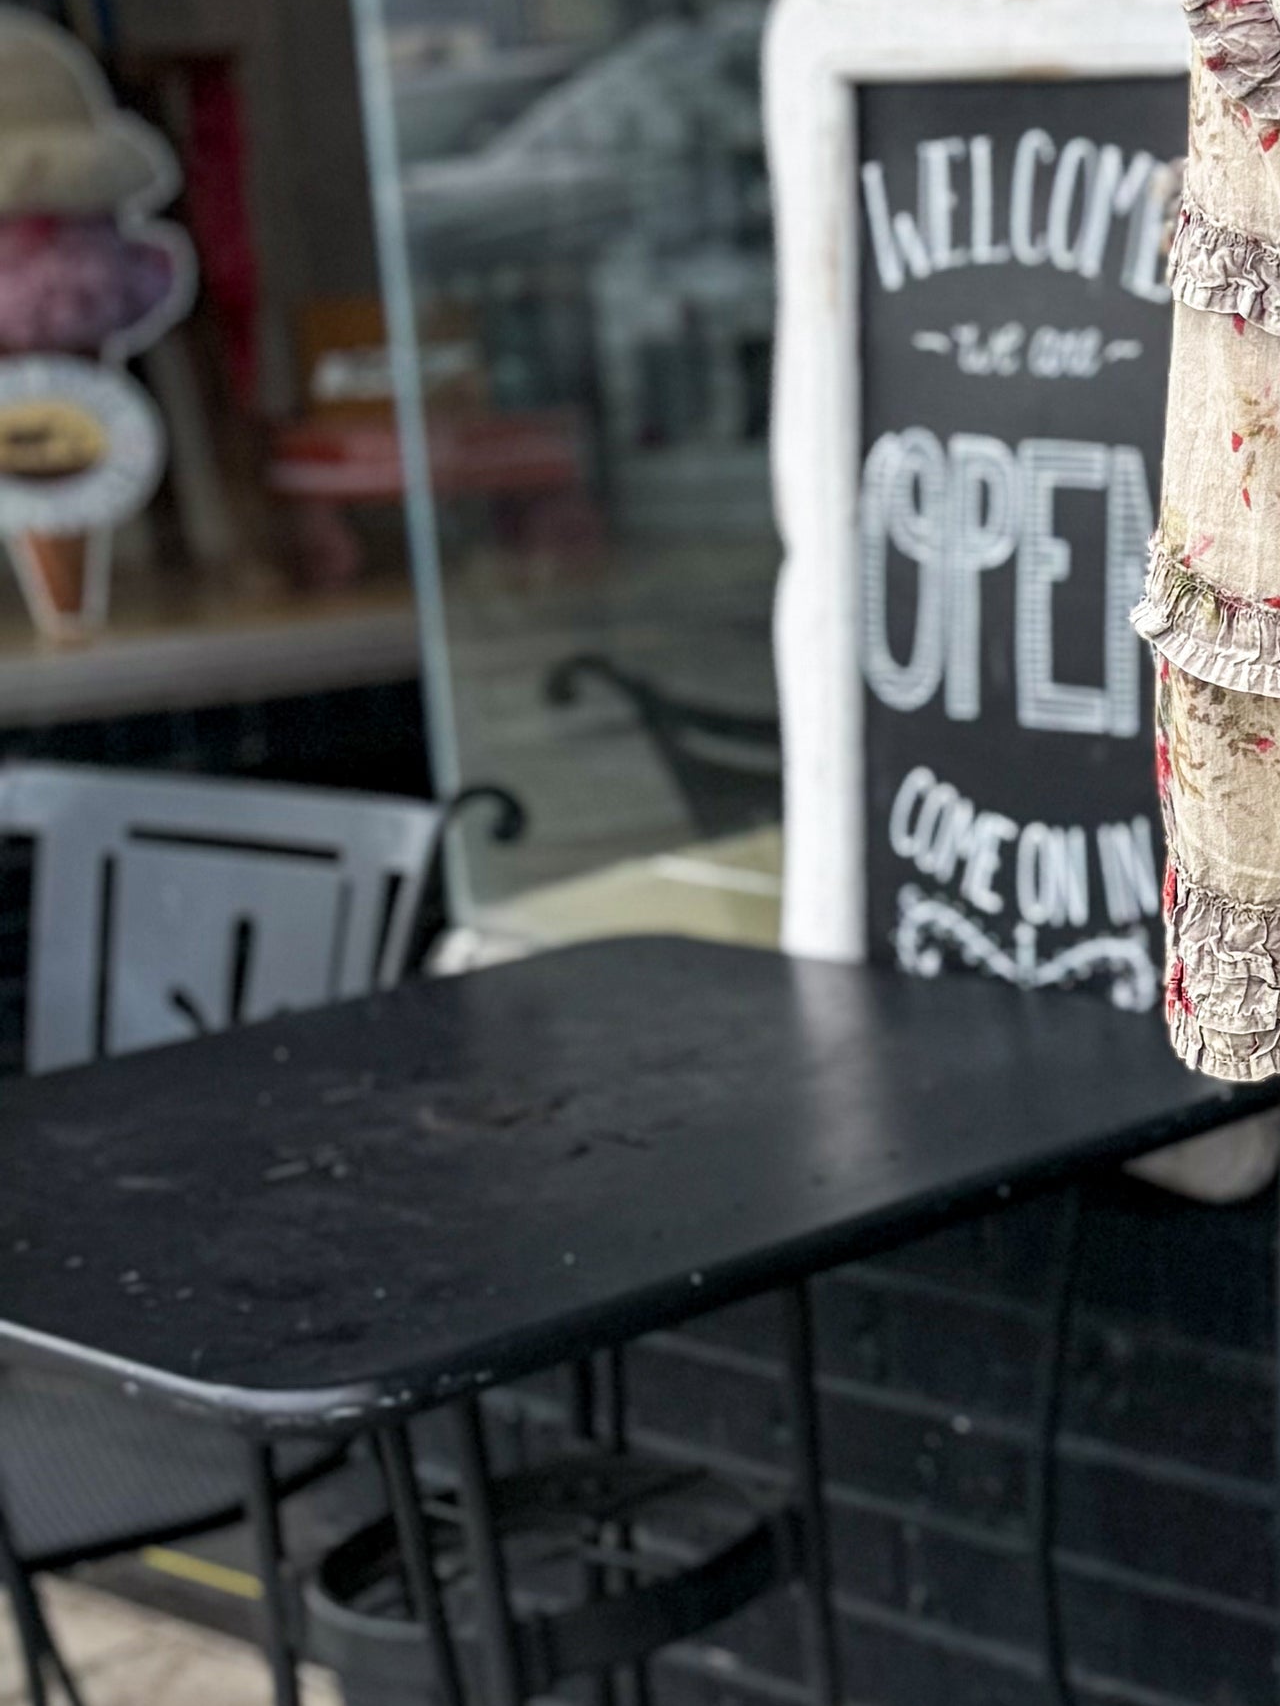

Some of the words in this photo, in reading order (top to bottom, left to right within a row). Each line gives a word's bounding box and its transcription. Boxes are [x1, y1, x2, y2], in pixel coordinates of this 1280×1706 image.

[862, 127, 1174, 305] WELCOME
[888, 765, 1019, 915] COME
[1015, 820, 1089, 927] ON
[1096, 813, 1159, 927] IN
